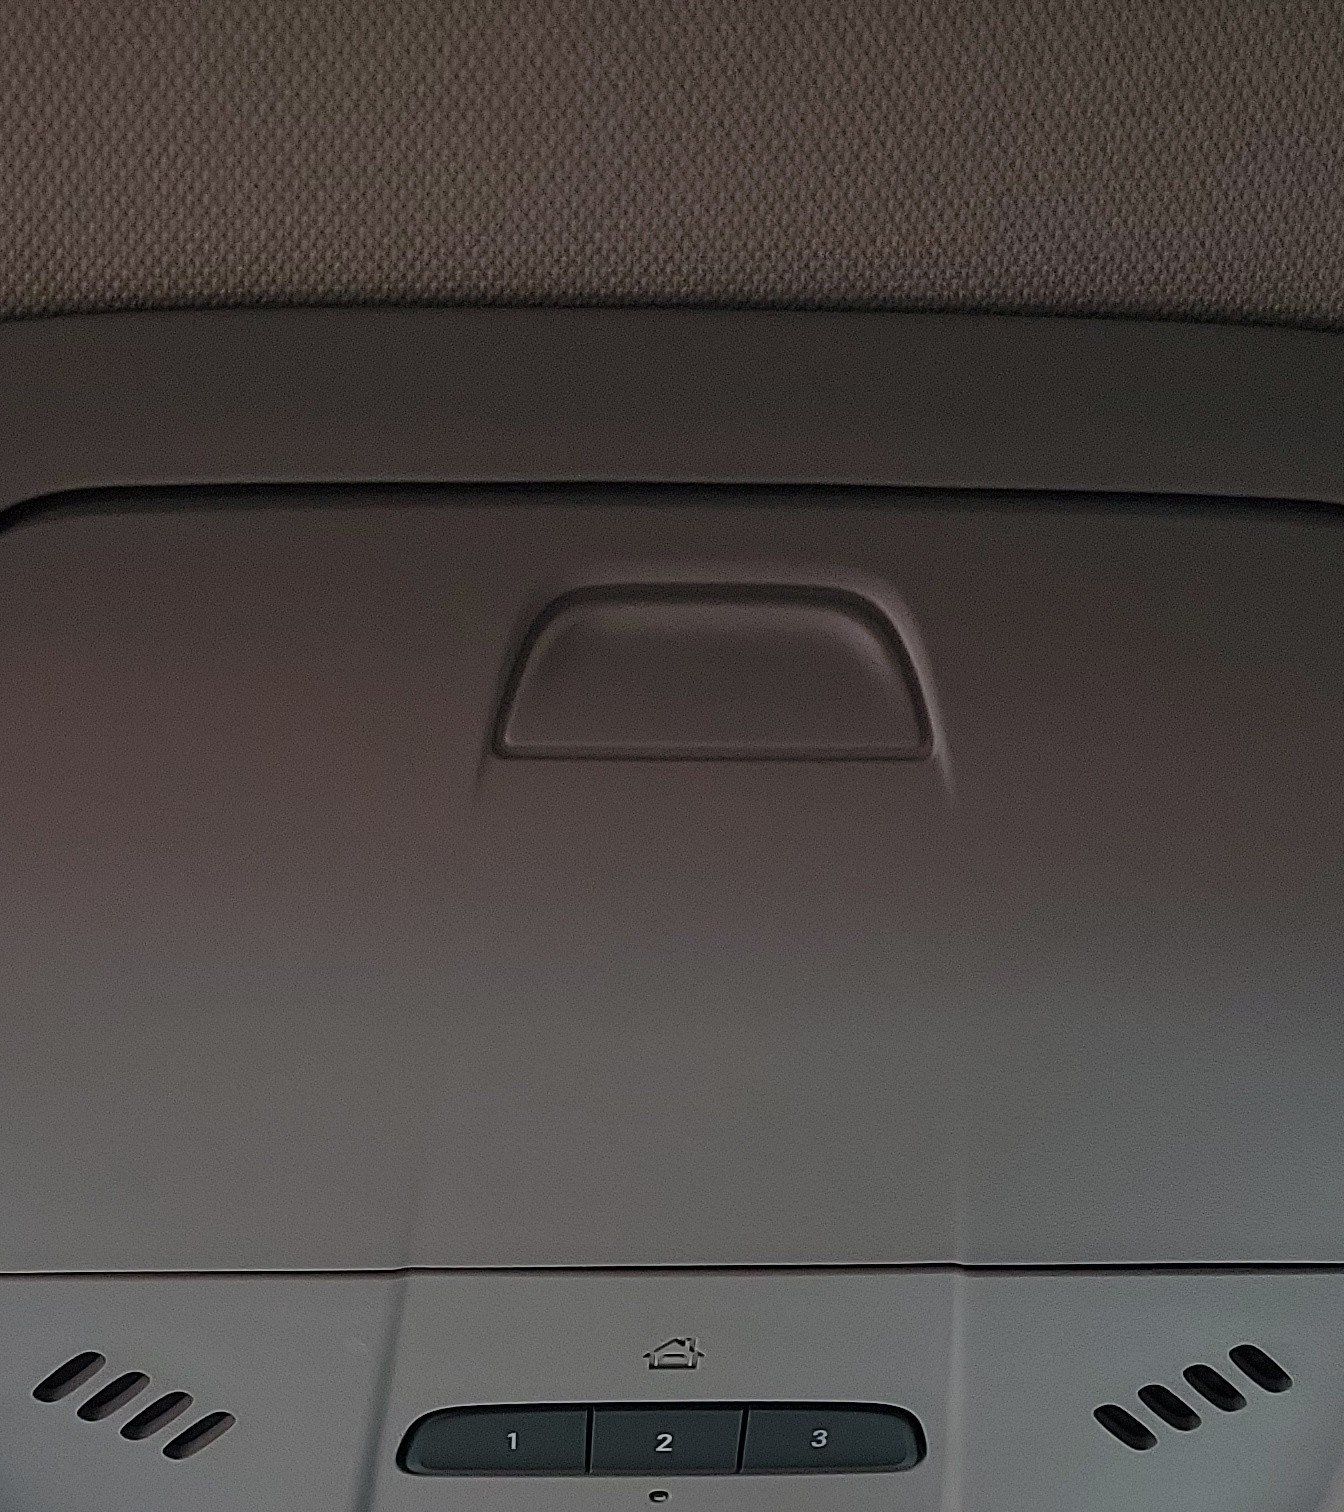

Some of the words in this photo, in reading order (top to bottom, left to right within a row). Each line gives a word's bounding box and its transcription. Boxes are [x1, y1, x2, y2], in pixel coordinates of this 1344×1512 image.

[506, 1432, 518, 1450] 1
[655, 1433, 673, 1451] 2
[811, 1430, 829, 1448] 3
